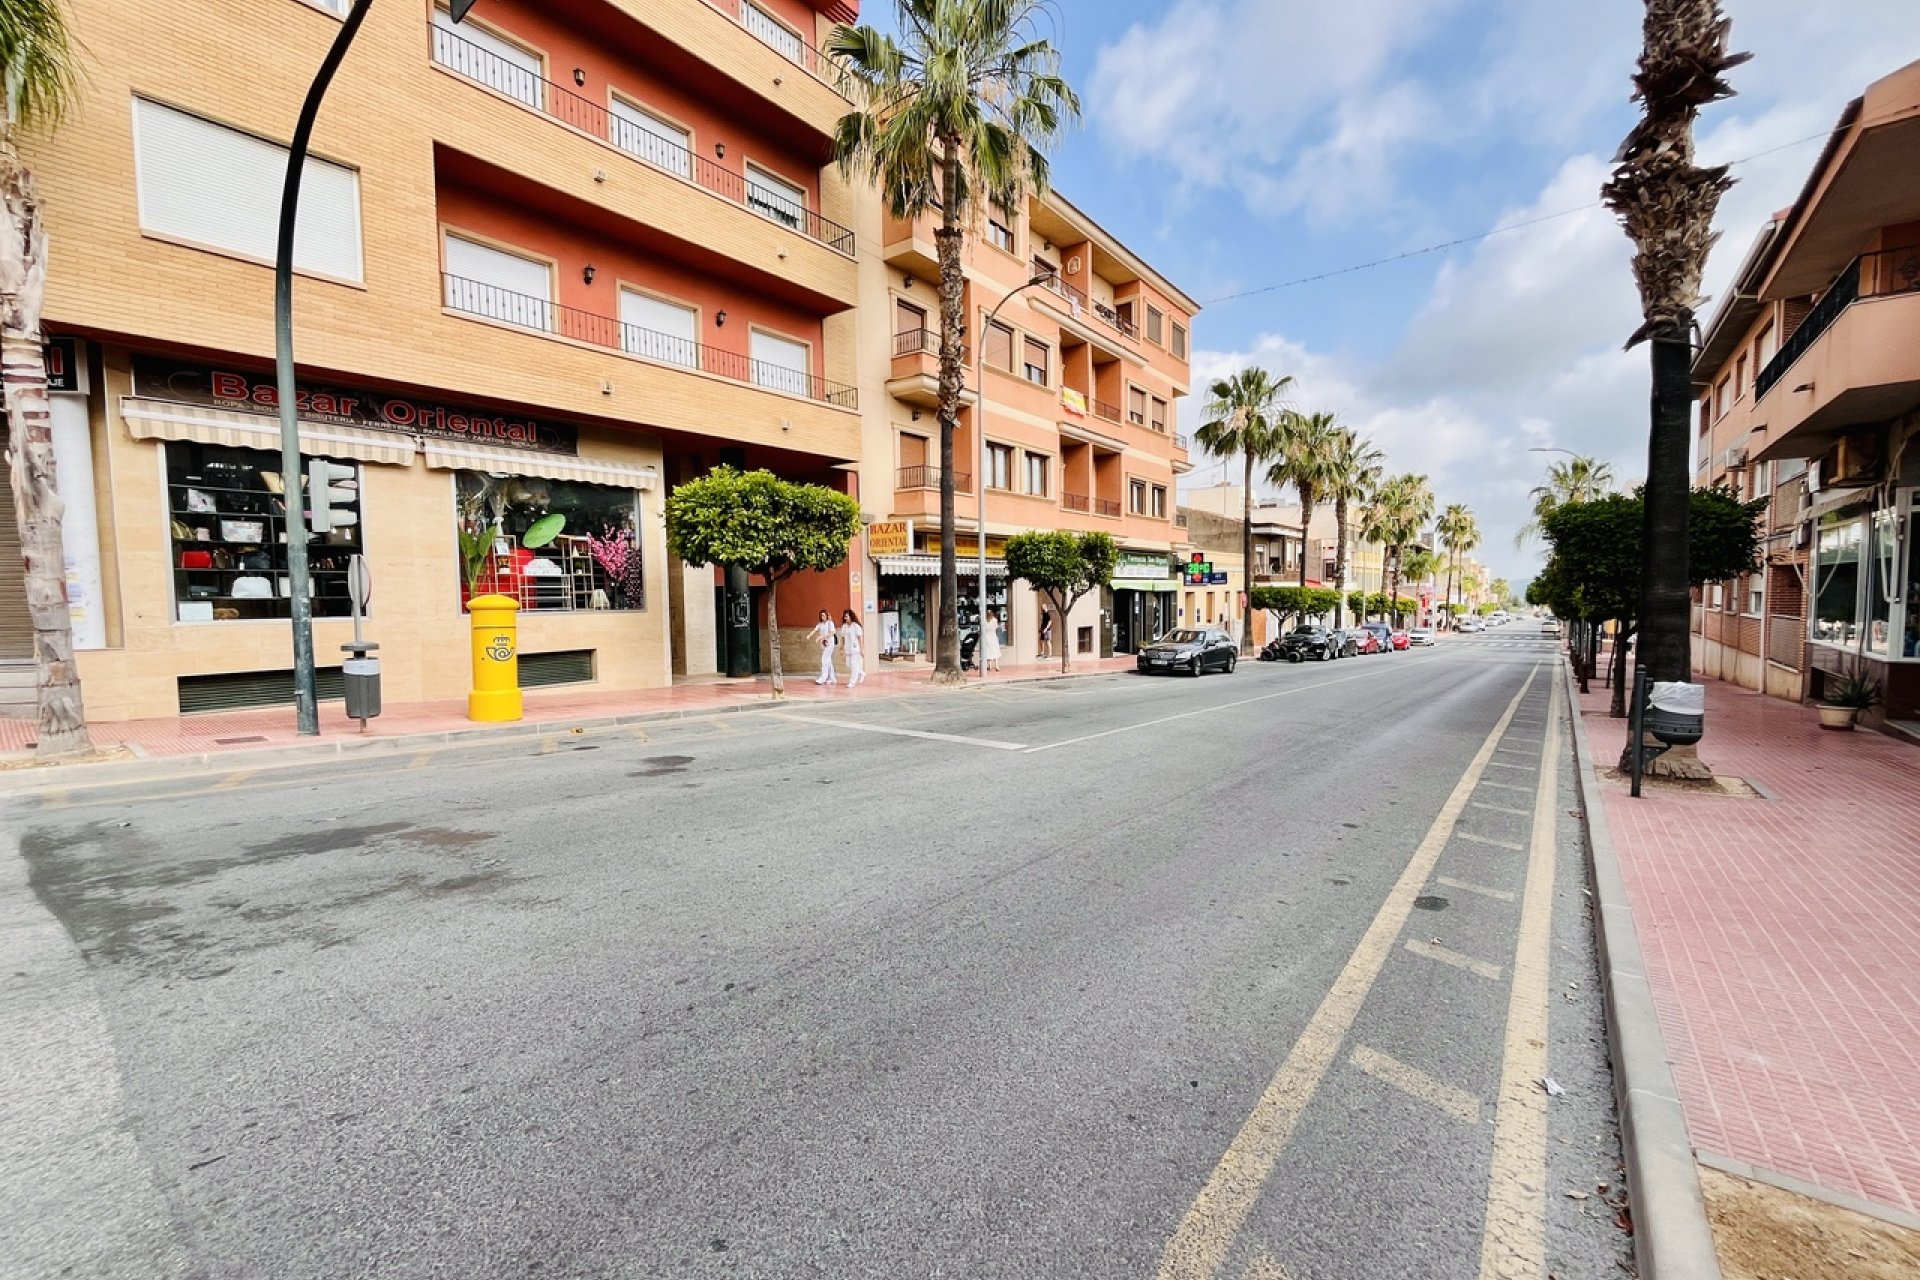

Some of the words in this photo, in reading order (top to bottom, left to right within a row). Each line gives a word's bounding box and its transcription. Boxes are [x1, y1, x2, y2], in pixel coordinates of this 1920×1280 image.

[211, 371, 359, 416] Bazar
[383, 400, 538, 443] Oriental
[214, 400, 245, 410] ROPA
[869, 522, 907, 535] BAZAR
